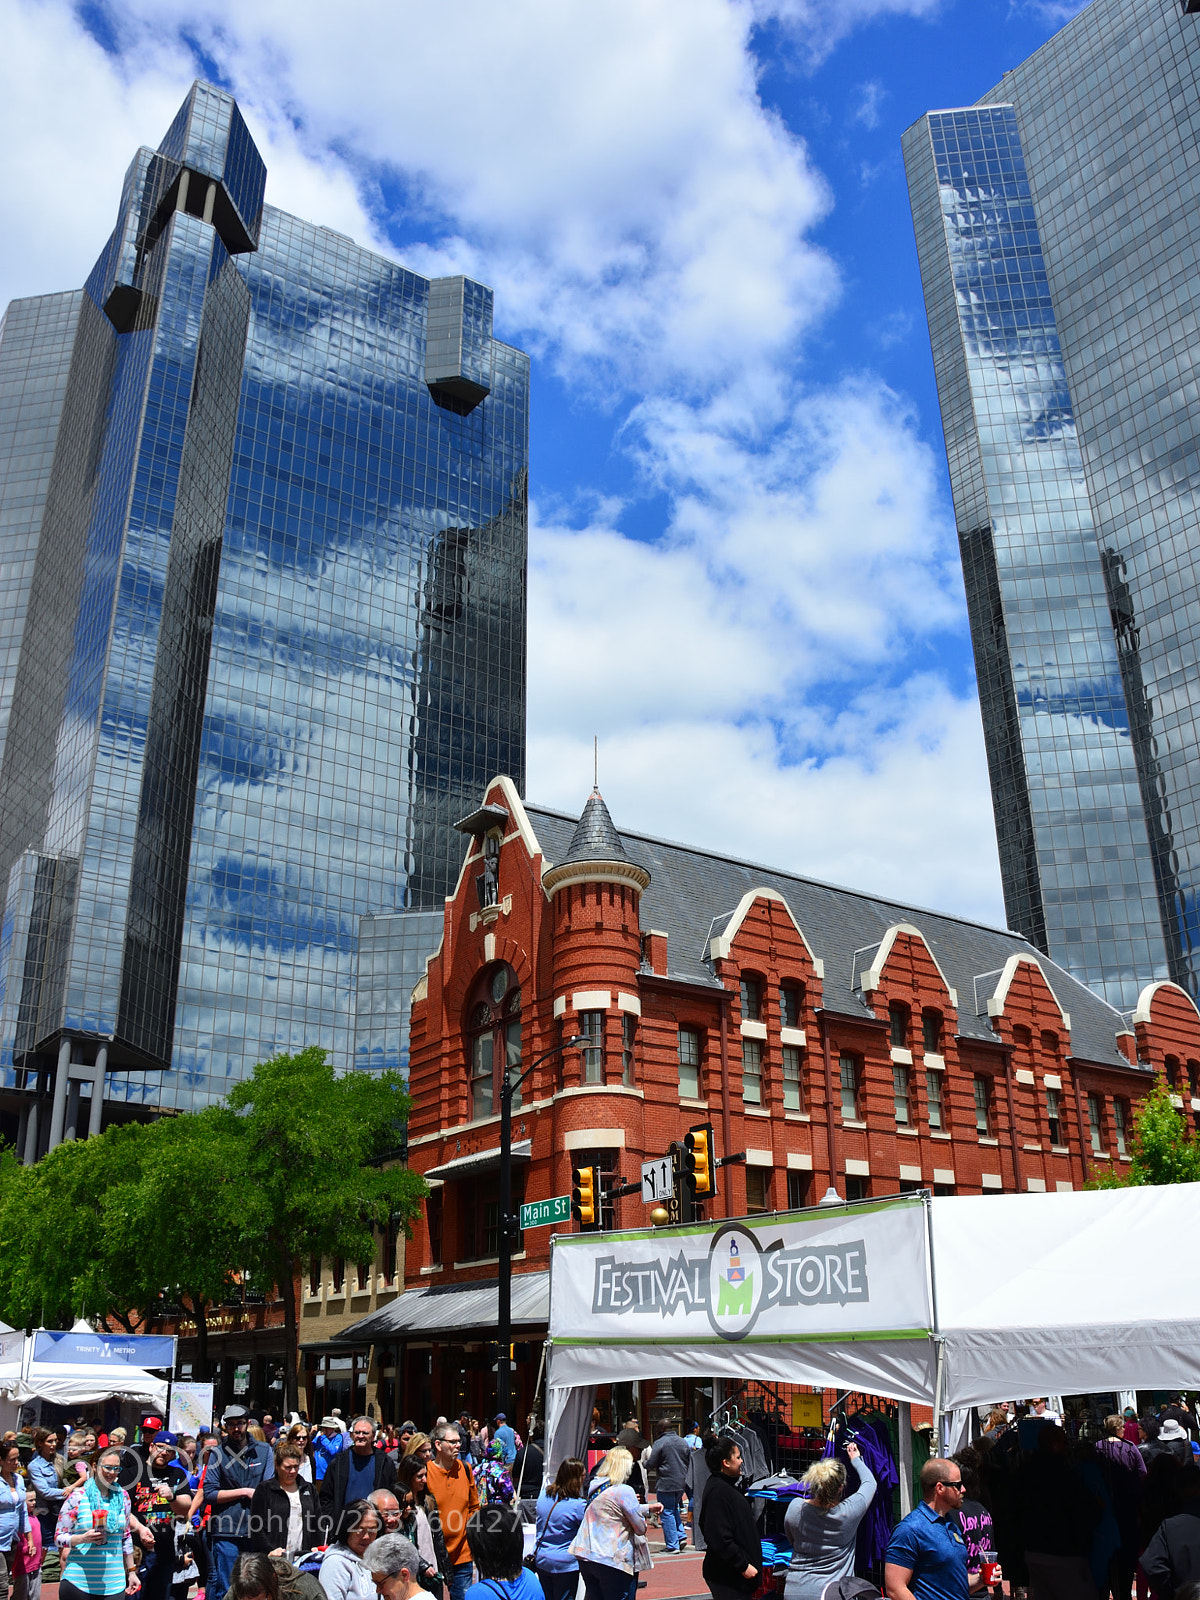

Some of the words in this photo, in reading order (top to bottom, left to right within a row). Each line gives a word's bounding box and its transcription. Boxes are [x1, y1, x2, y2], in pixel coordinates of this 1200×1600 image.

[659, 1188, 671, 1197] ONLY
[523, 1203, 550, 1221] Main
[554, 1199, 566, 1215] St
[597, 1263, 706, 1307] FESTIVAL
[766, 1249, 863, 1300] STORE
[76, 1345, 101, 1353] TRINITY
